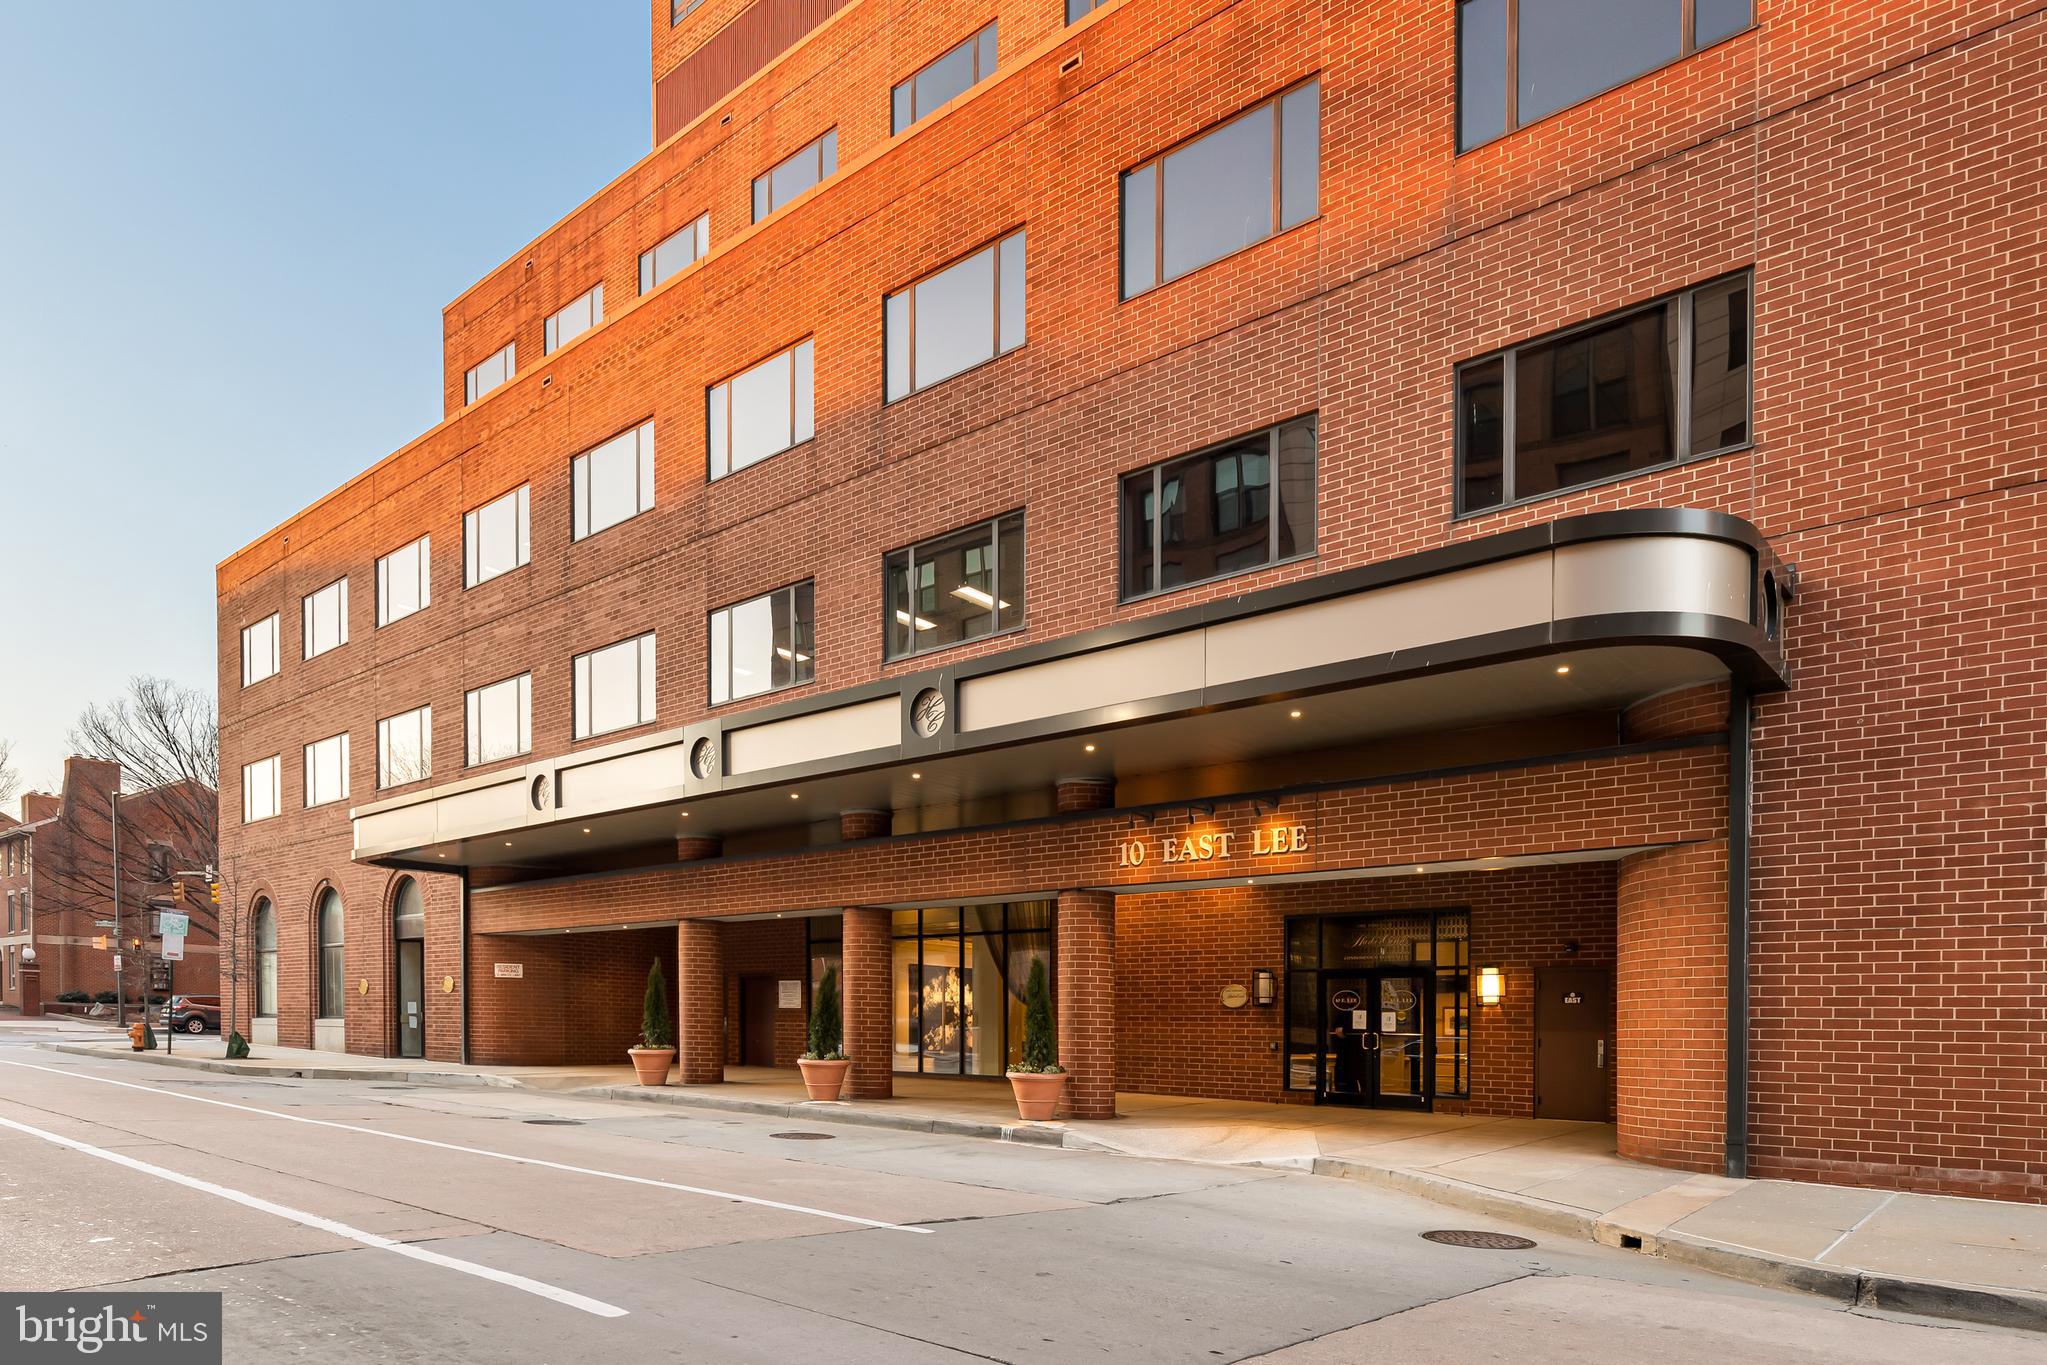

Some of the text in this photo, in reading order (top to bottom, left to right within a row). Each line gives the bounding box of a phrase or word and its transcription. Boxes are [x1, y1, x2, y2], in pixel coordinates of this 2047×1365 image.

[1119, 825, 1308, 866] 10 EAST LEE
